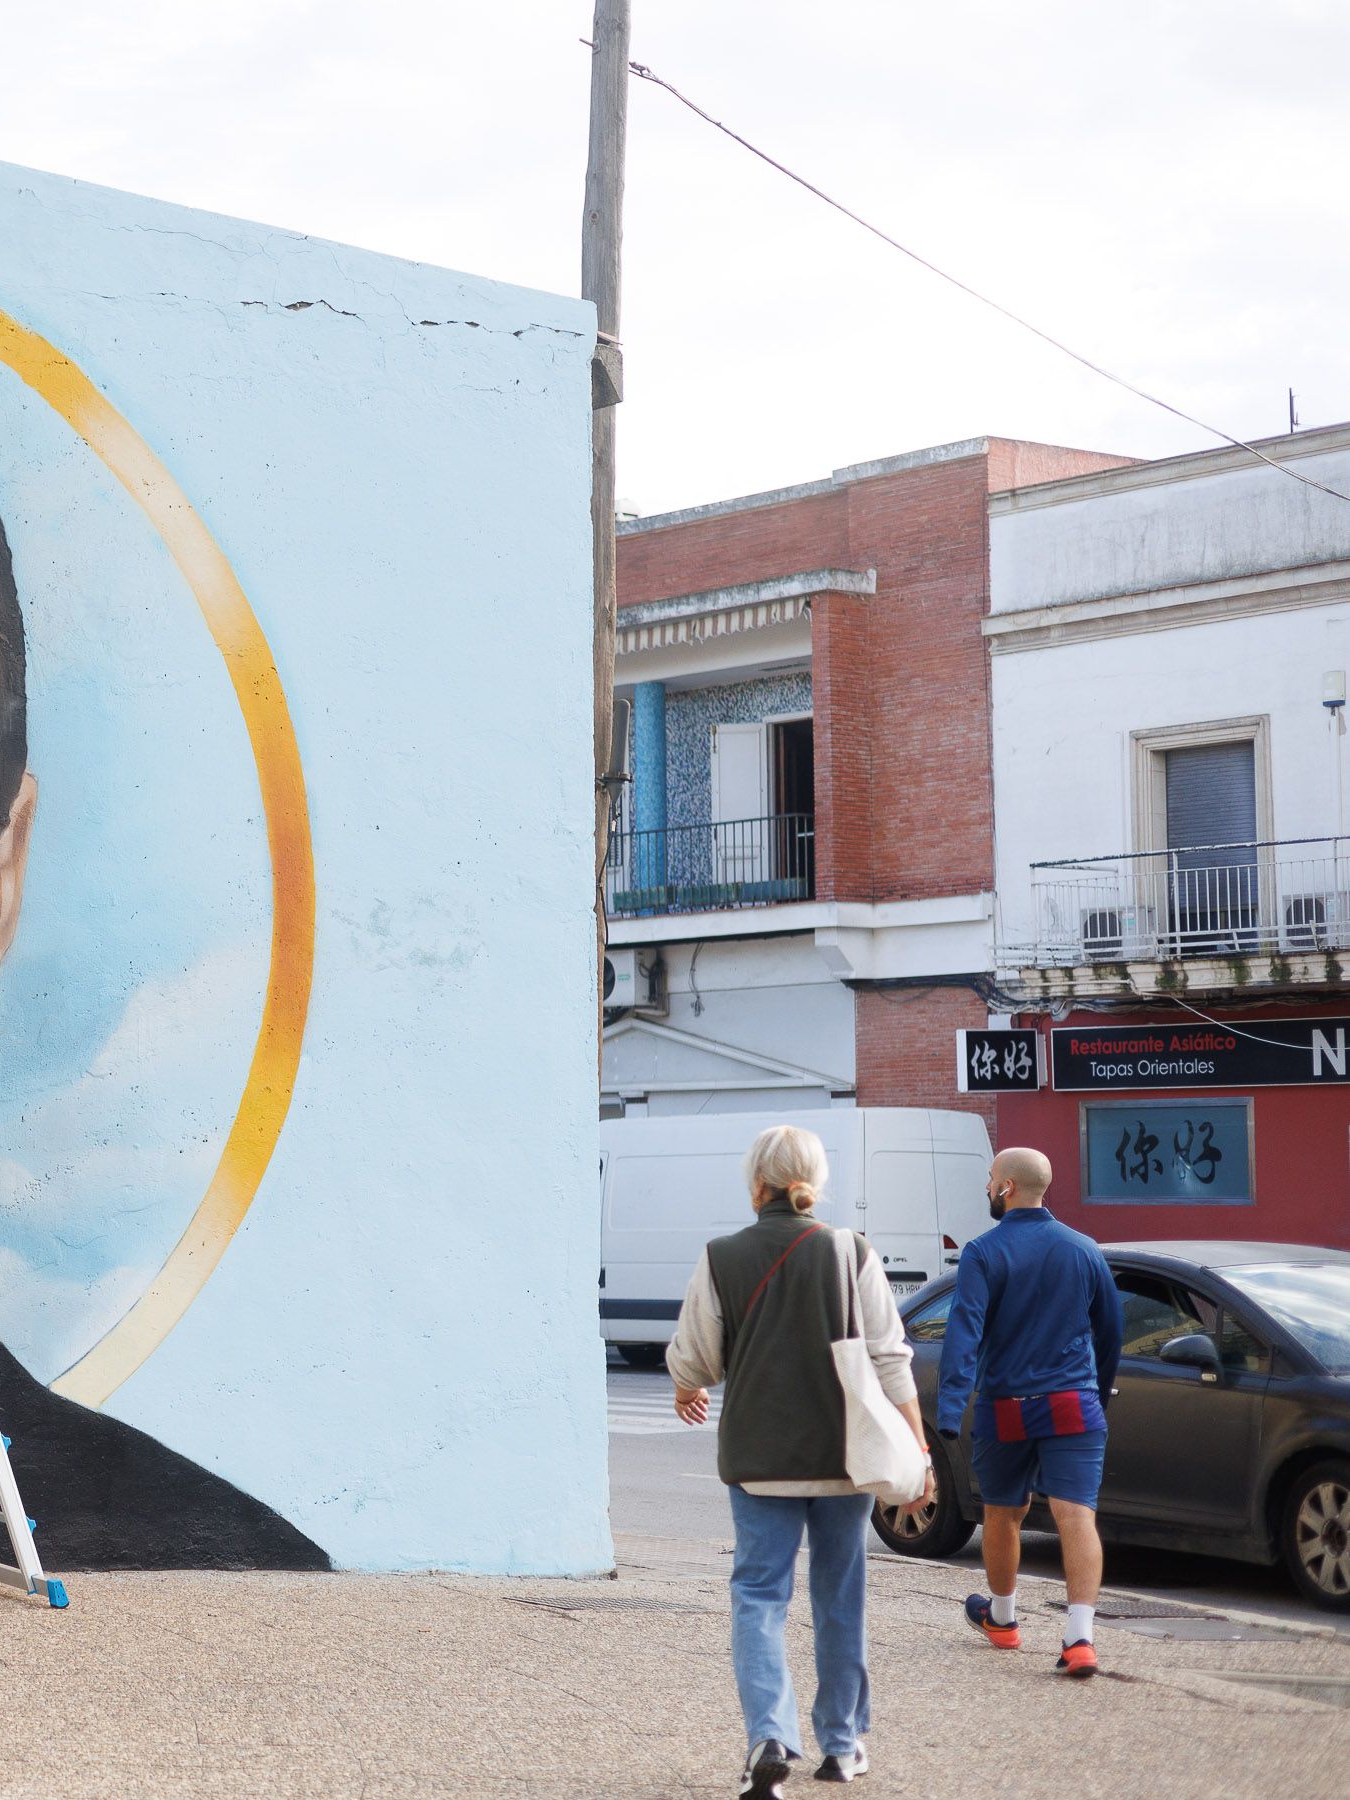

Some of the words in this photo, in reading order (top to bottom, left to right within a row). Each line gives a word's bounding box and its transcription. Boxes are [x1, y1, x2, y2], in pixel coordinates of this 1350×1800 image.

[971, 1040, 1032, 1080] 你好
[1070, 1035, 1164, 1055] Restaurante
[1169, 1032, 1237, 1051] Asiático
[1312, 1028, 1346, 1076] N
[1090, 1061, 1134, 1080] Tapas
[1137, 1058, 1215, 1077] Orientales
[1115, 1119, 1222, 1184] 你好
